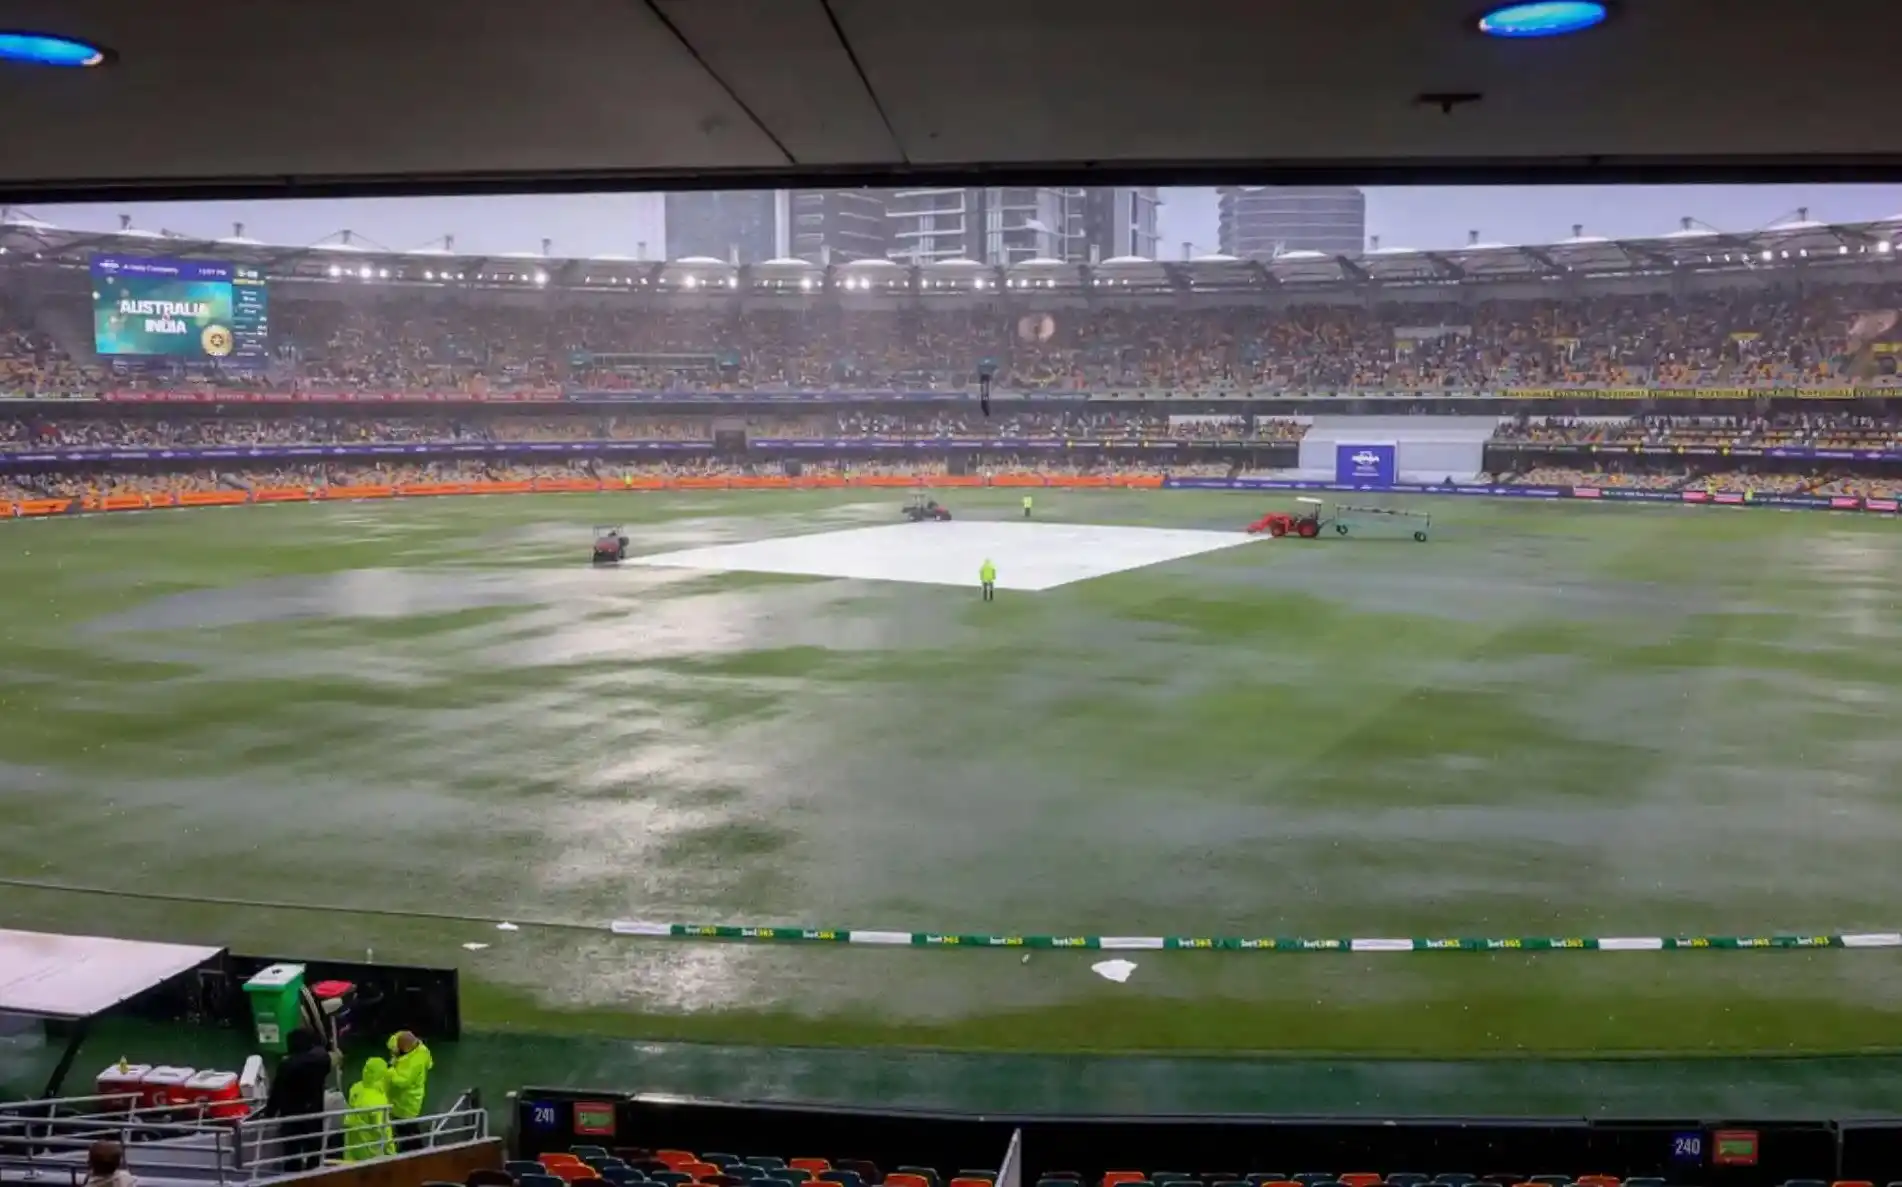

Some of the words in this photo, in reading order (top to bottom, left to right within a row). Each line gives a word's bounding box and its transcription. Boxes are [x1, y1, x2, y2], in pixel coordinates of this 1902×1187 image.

[120, 300, 209, 317] AUSTRALIA
[144, 319, 187, 334] INDIA
[1178, 937, 1212, 948] bet365
[1426, 937, 1461, 948] bet365
[1487, 937, 1521, 948] bet365
[1550, 937, 1584, 948] bet365
[534, 1107, 555, 1123] 241
[1675, 1138, 1700, 1155] 240
